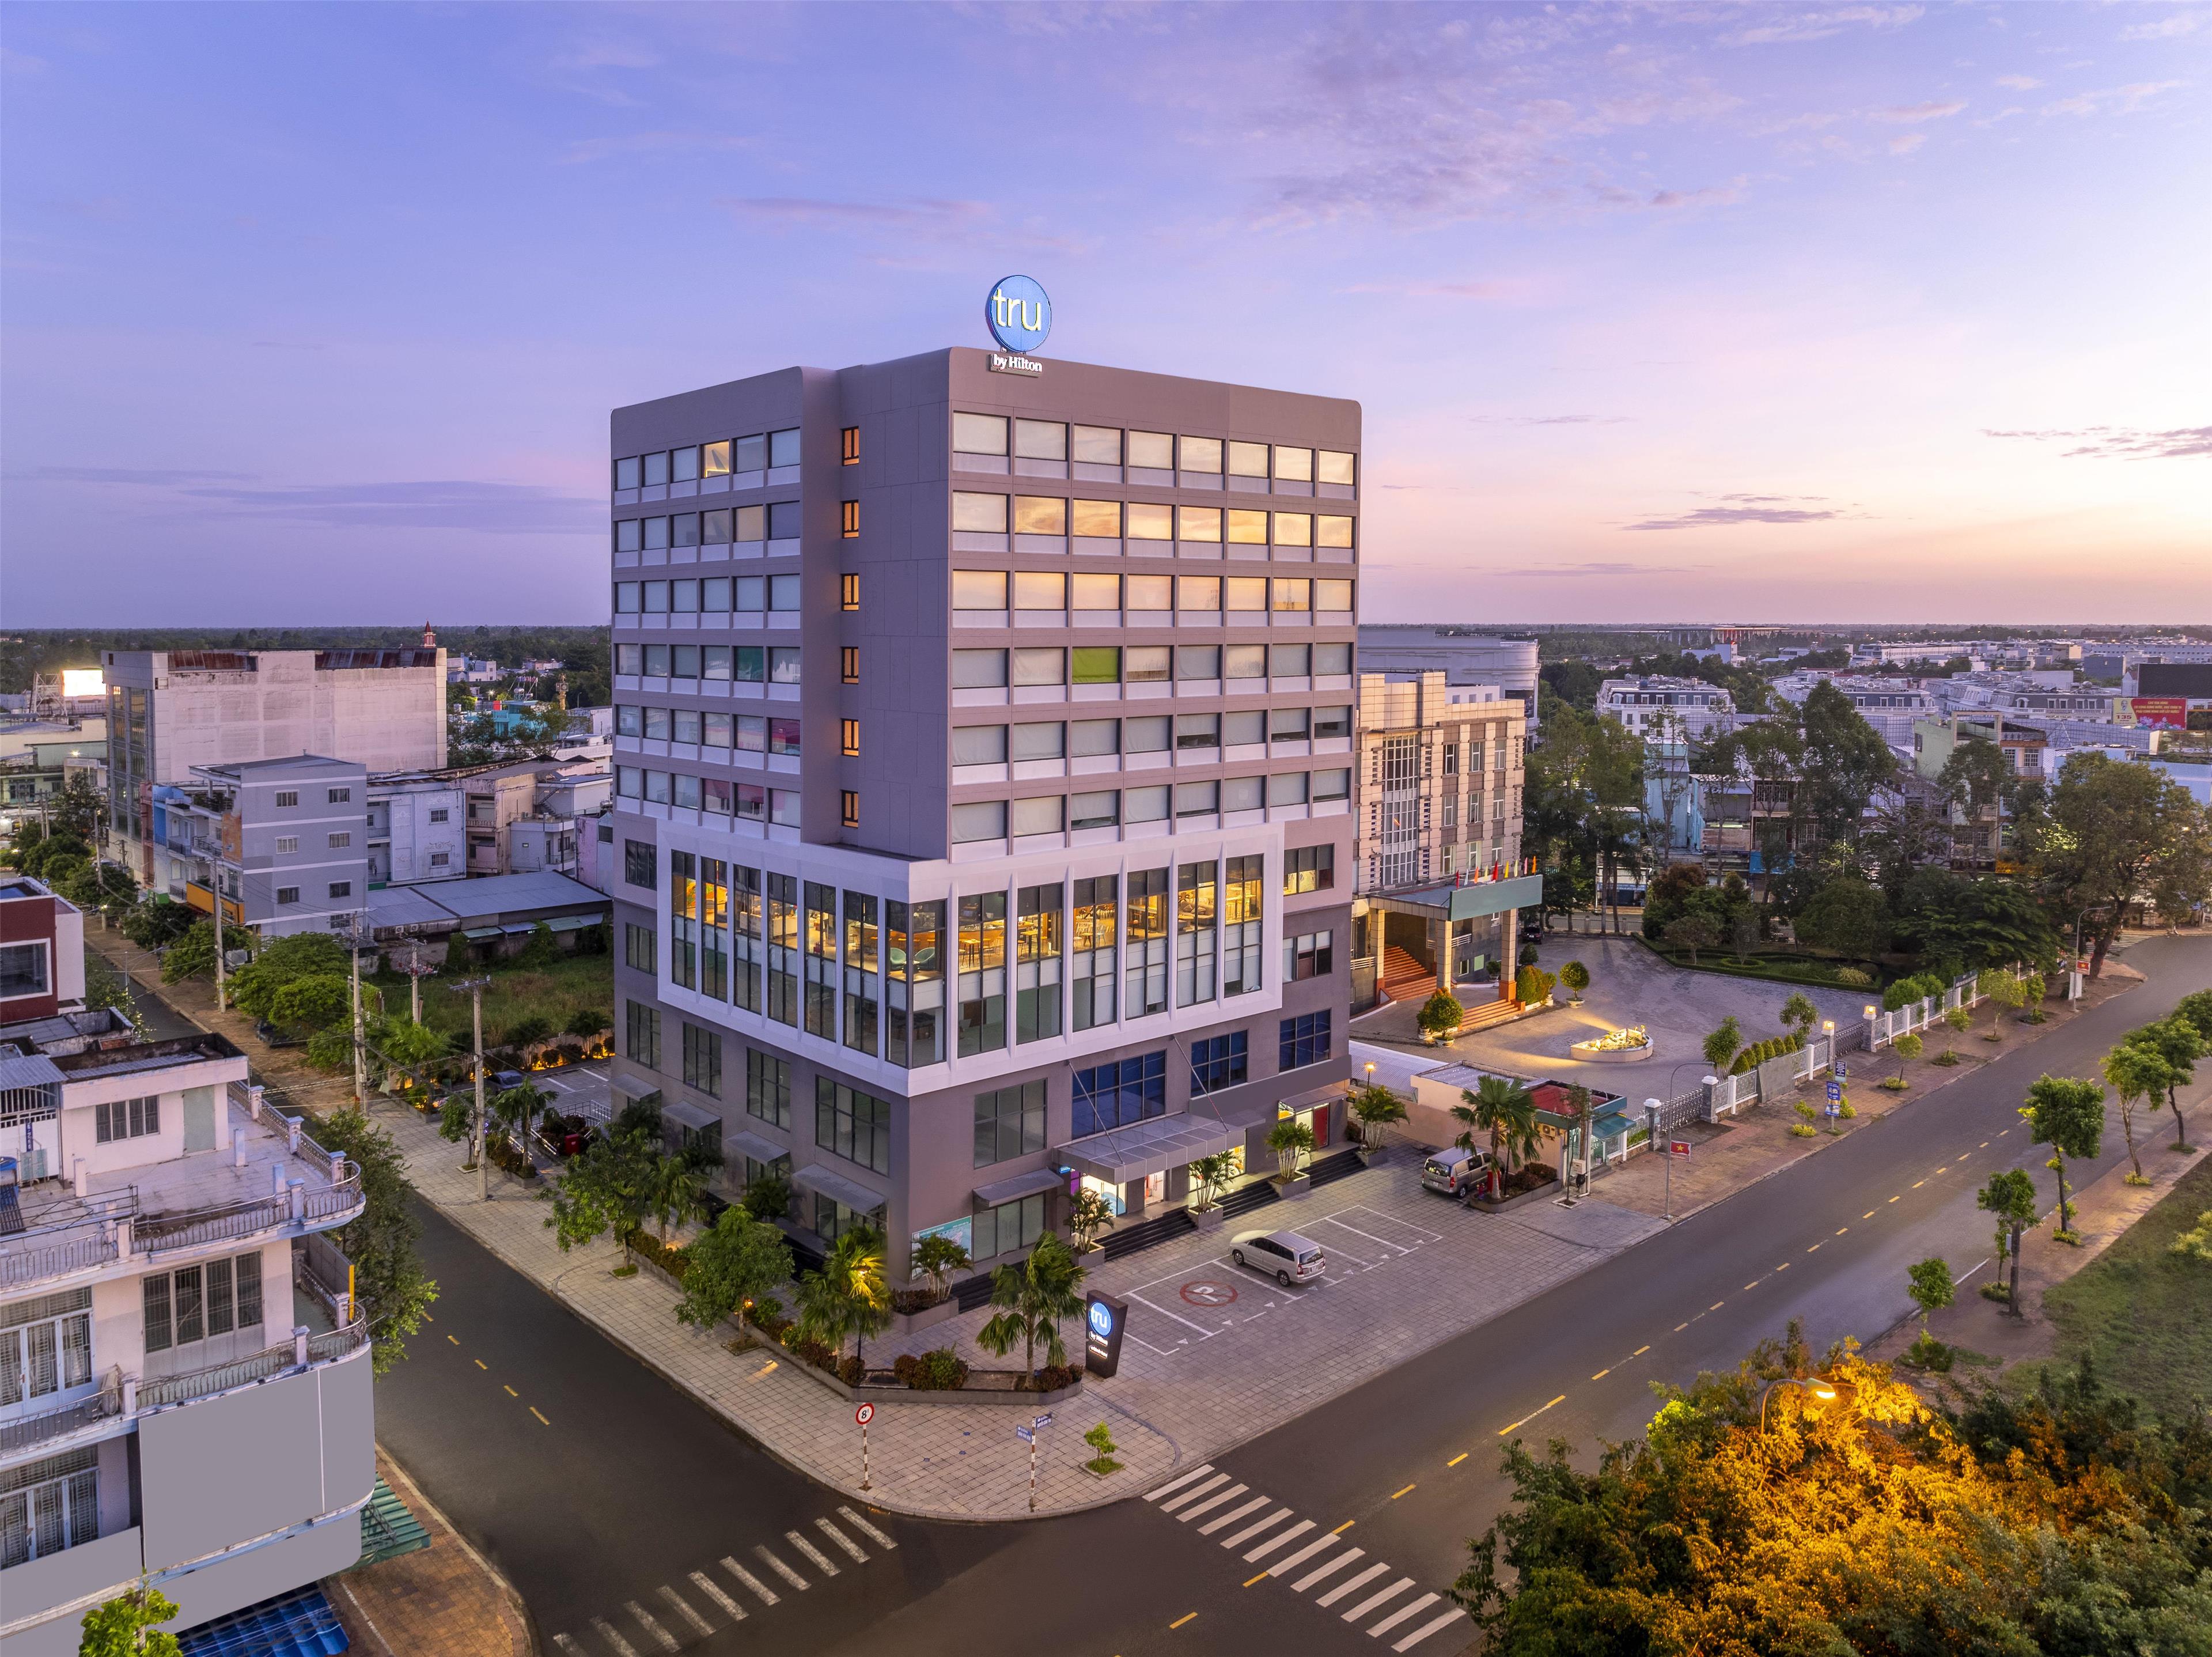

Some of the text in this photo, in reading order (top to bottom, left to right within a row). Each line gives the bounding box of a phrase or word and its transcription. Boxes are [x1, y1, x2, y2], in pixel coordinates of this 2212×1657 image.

[991, 288, 1041, 331] tru
[993, 354, 1042, 372] by Hilton
[1090, 1306, 1107, 1329] tru
